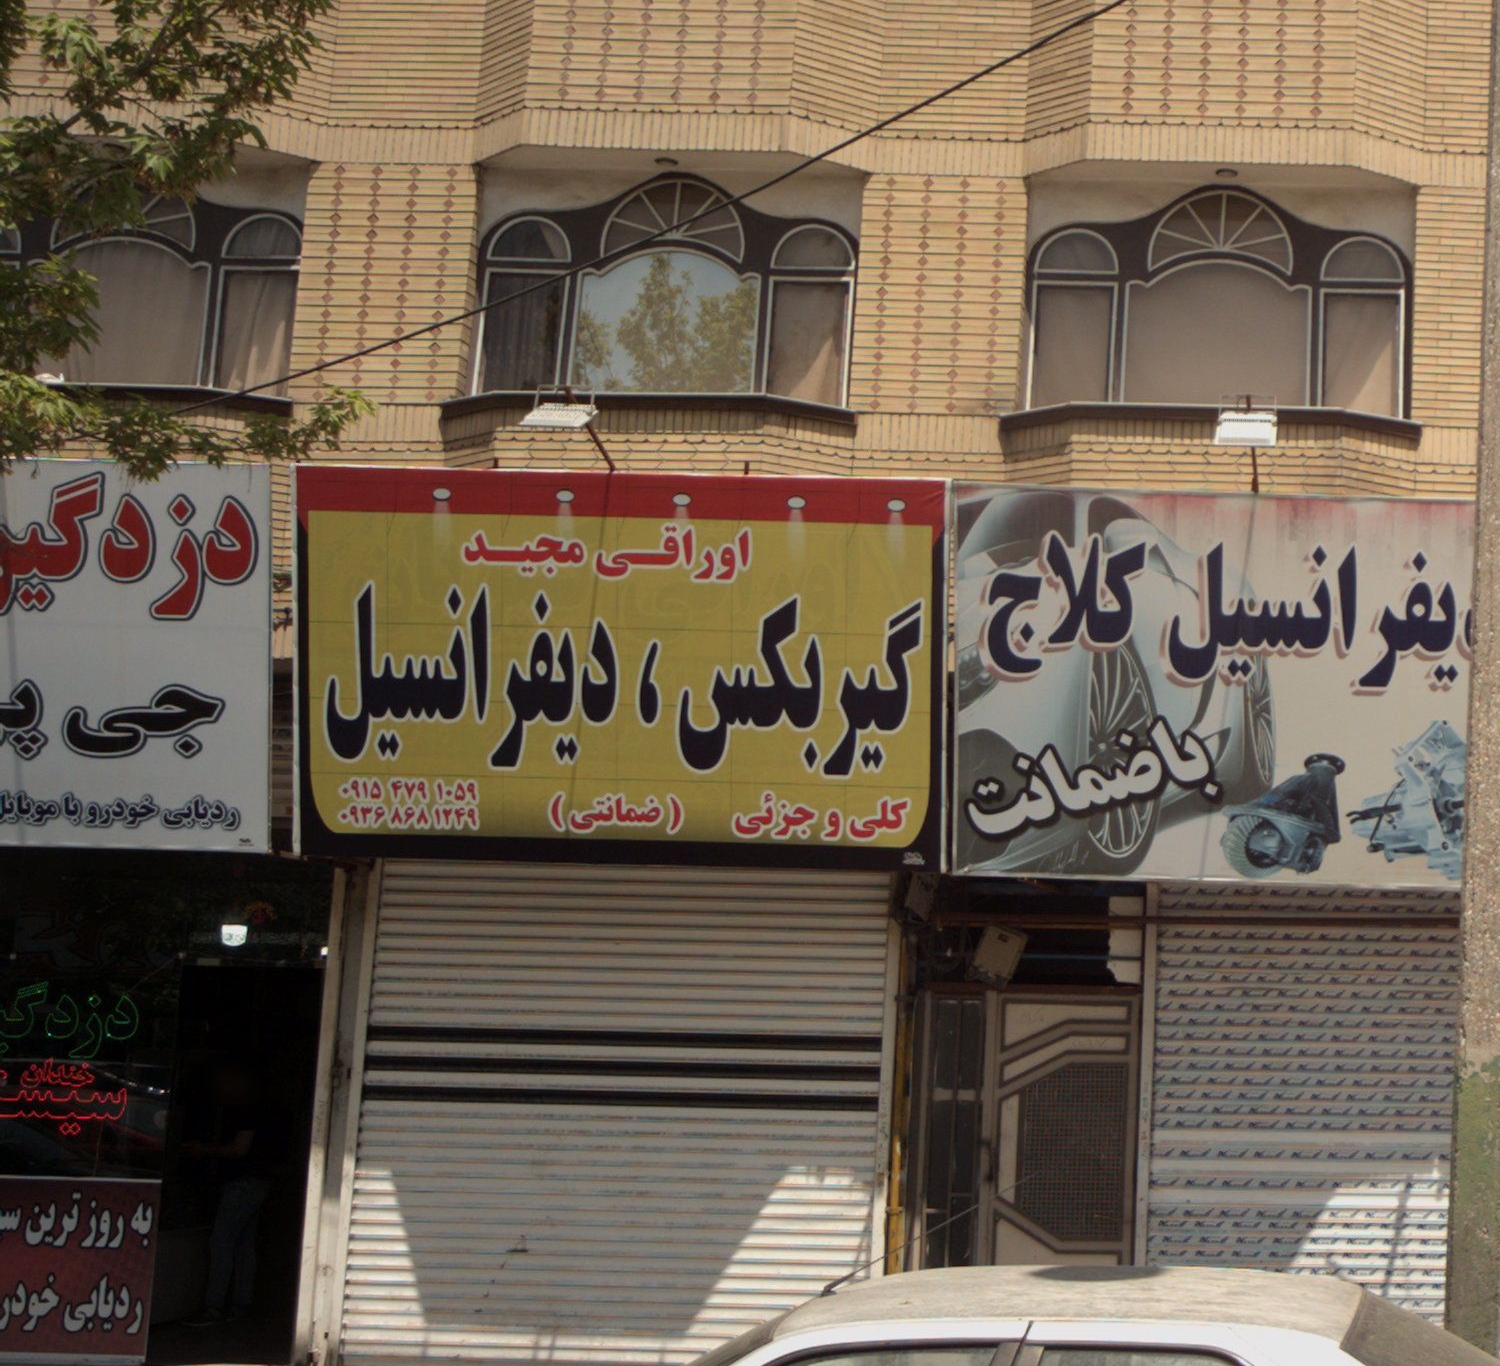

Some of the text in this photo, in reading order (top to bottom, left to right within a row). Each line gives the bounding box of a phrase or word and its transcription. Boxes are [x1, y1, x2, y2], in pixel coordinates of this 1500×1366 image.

[463, 524, 751, 581] اوراقی مجید
[985, 530, 1147, 676] کلاج
[1168, 541, 1473, 688] یفرانسیل
[323, 580, 619, 770] دیفرانسیل
[678, 593, 926, 777] گیربکس
[62, 683, 226, 759] جی
[61, 791, 83, 826] با
[84, 792, 159, 829] خودرو
[162, 794, 241, 831] ردیابی
[338, 777, 384, 803] ۰۹۱۵
[733, 790, 912, 841] کلی و جزئی
[0, 979, 141, 1060] دزدگ
[130, 1200, 154, 1249] به
[0, 1272, 144, 1335] ردیابی خودر
